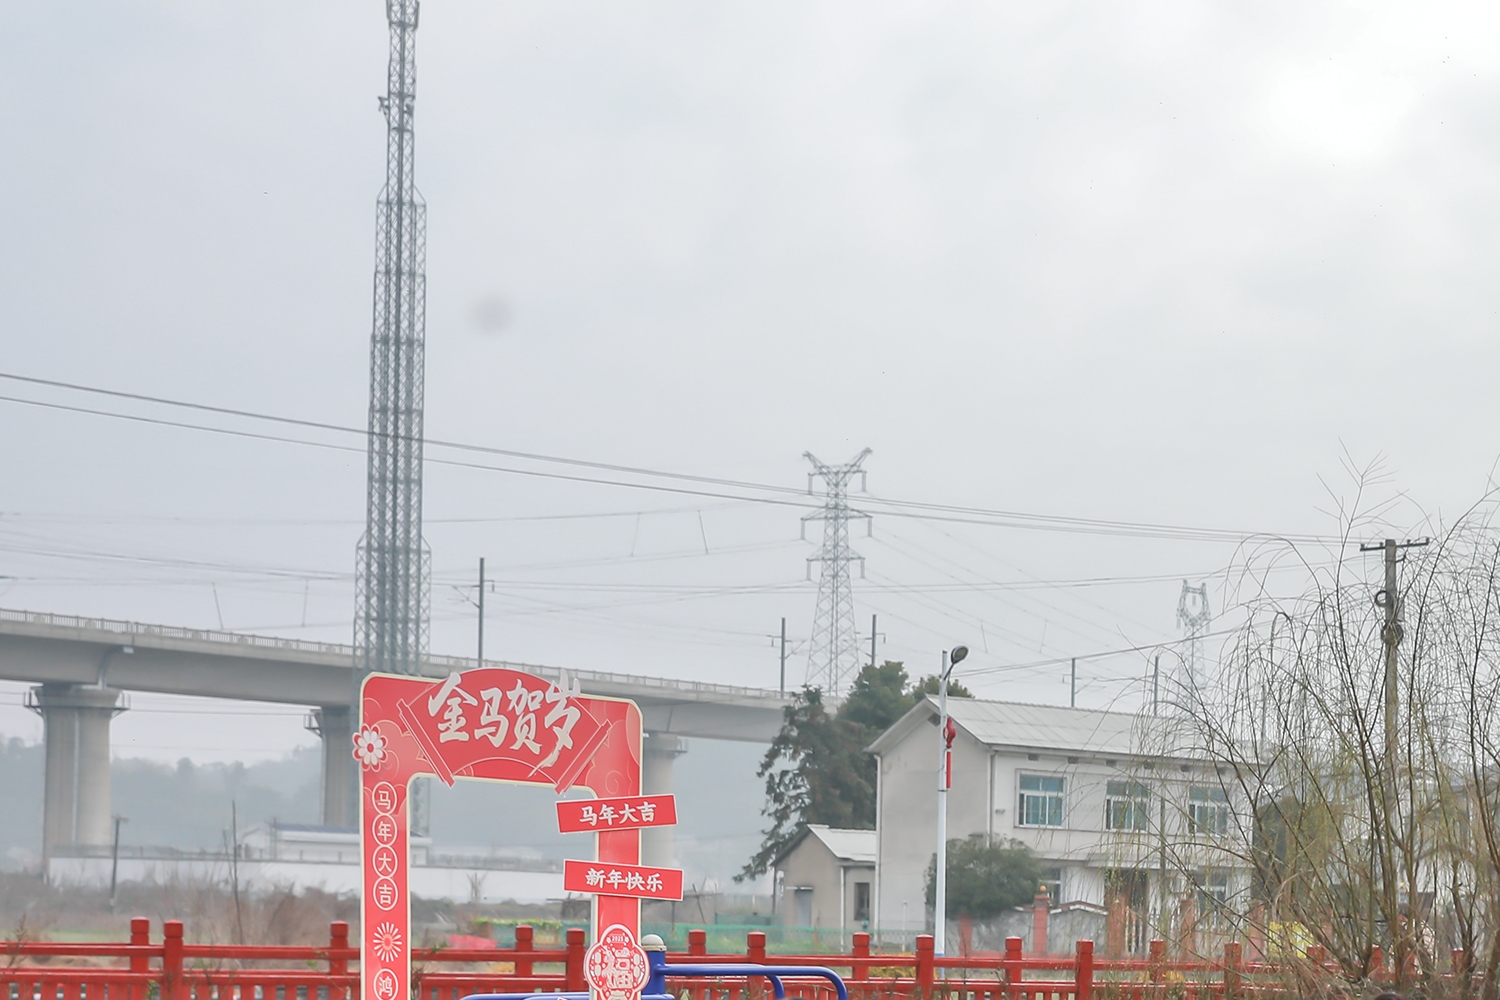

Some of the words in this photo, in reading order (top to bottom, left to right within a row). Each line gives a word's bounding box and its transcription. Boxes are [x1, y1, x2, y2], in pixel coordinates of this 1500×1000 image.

[428, 670, 581, 777] 金马贺岁
[579, 801, 657, 826] 马年大吉
[378, 790, 393, 905] 马年大吉
[585, 868, 664, 894] 新年快乐
